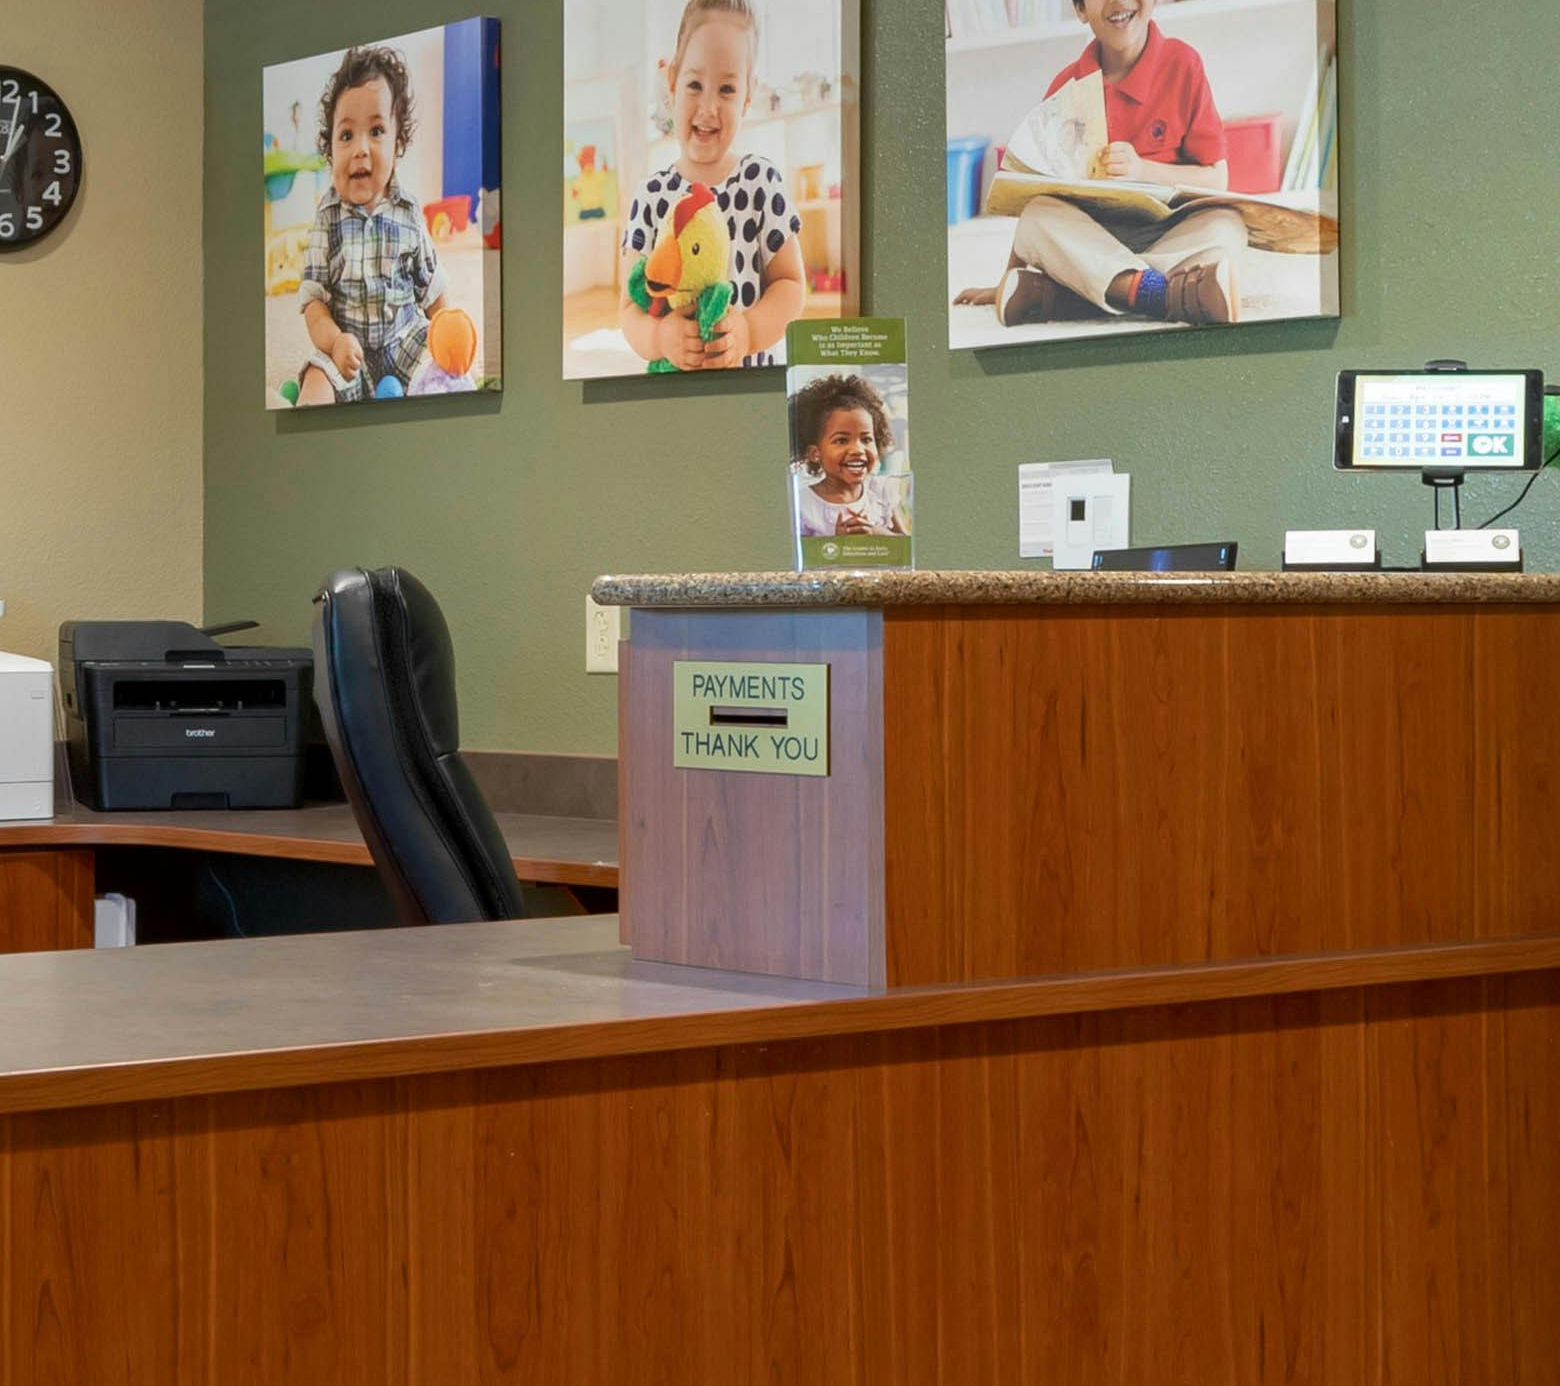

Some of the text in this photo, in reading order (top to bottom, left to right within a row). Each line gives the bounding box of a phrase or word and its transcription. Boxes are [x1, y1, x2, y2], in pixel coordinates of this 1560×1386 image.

[28, 91, 39, 114] 1
[44, 113, 62, 138] 2
[53, 149, 71, 175] 3
[42, 180, 62, 206] 4
[26, 206, 44, 230] 5
[1472, 435, 1508, 455] OK
[692, 674, 805, 701] PAYMENTS
[185, 728, 215, 737] brother
[681, 732, 818, 761] THANK YOU
